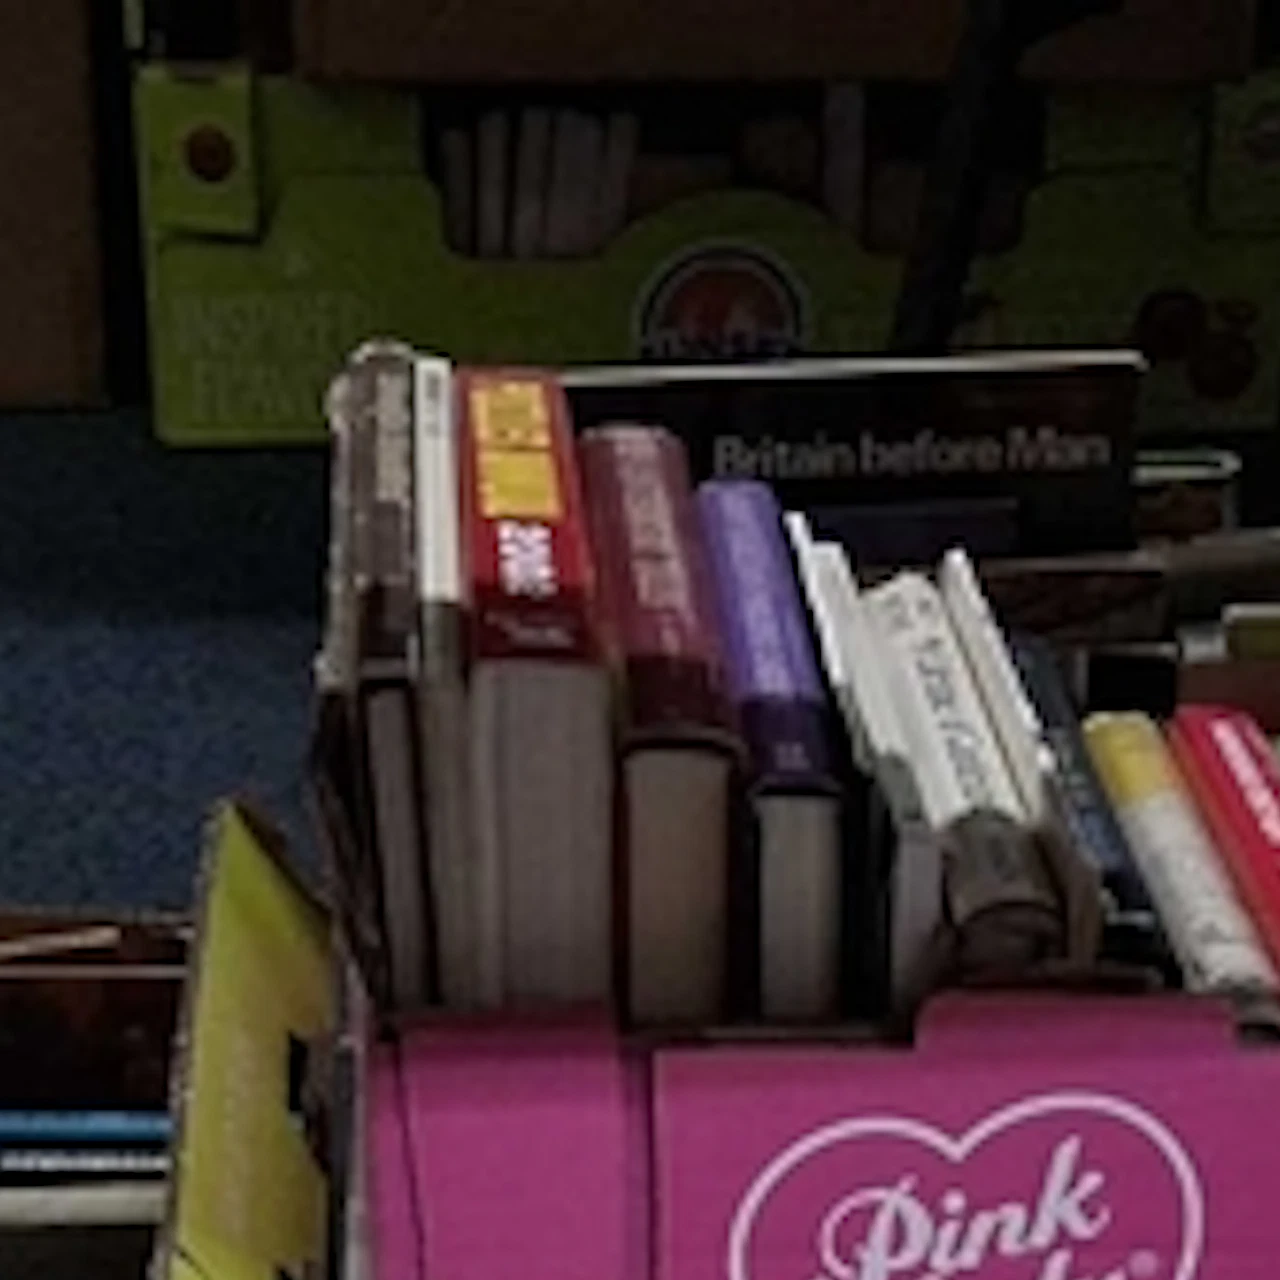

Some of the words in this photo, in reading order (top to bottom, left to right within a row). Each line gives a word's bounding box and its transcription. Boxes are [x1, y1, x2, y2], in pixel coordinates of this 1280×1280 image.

[719, 431, 855, 480] Britain
[860, 427, 998, 477] before
[1005, 425, 1116, 473] Man
